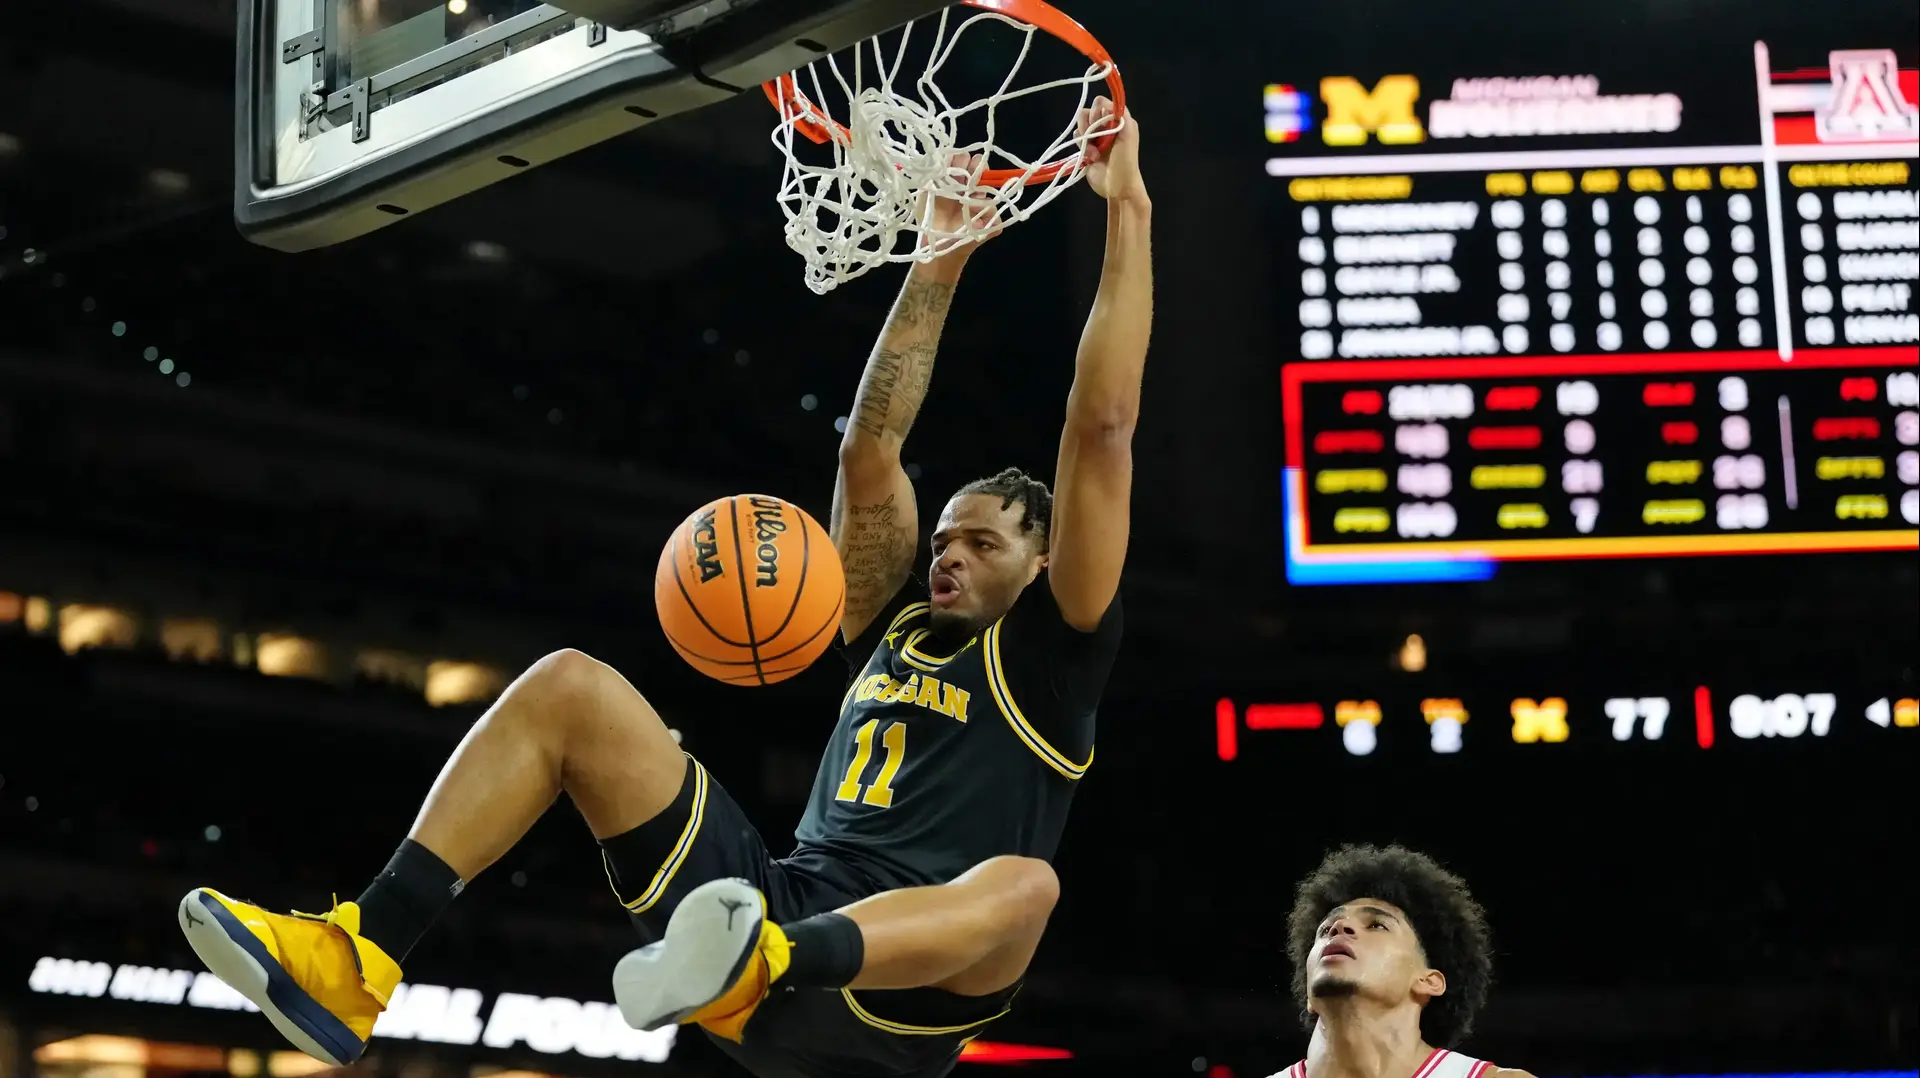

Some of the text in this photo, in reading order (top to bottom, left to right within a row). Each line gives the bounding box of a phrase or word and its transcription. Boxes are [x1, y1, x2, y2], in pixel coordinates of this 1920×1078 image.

[1320, 75, 1425, 146] M
[749, 496, 787, 588] Wilson
[1571, 498, 1598, 532] 7
[1605, 697, 1669, 740] 77
[835, 719, 907, 809] 11
